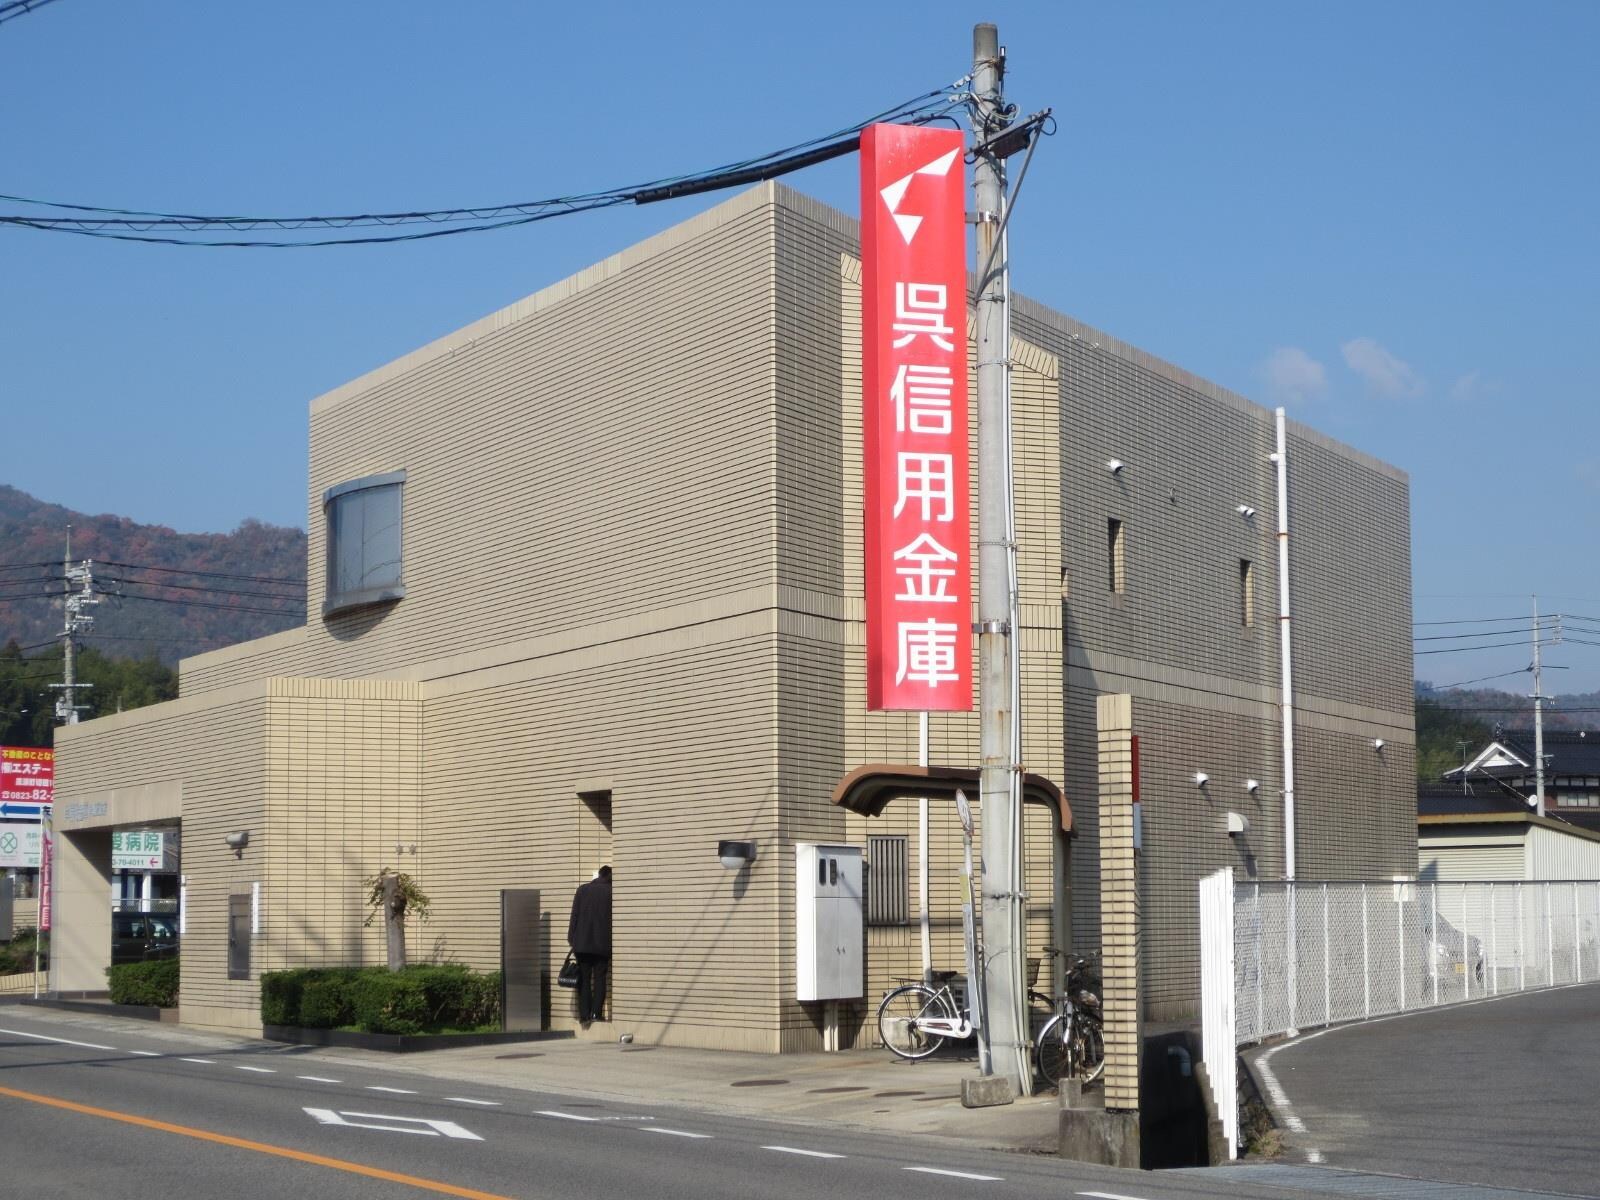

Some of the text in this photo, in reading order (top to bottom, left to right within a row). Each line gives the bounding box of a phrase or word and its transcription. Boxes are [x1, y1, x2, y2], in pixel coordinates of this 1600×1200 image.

[890, 281, 960, 689] 呉信用金庫
